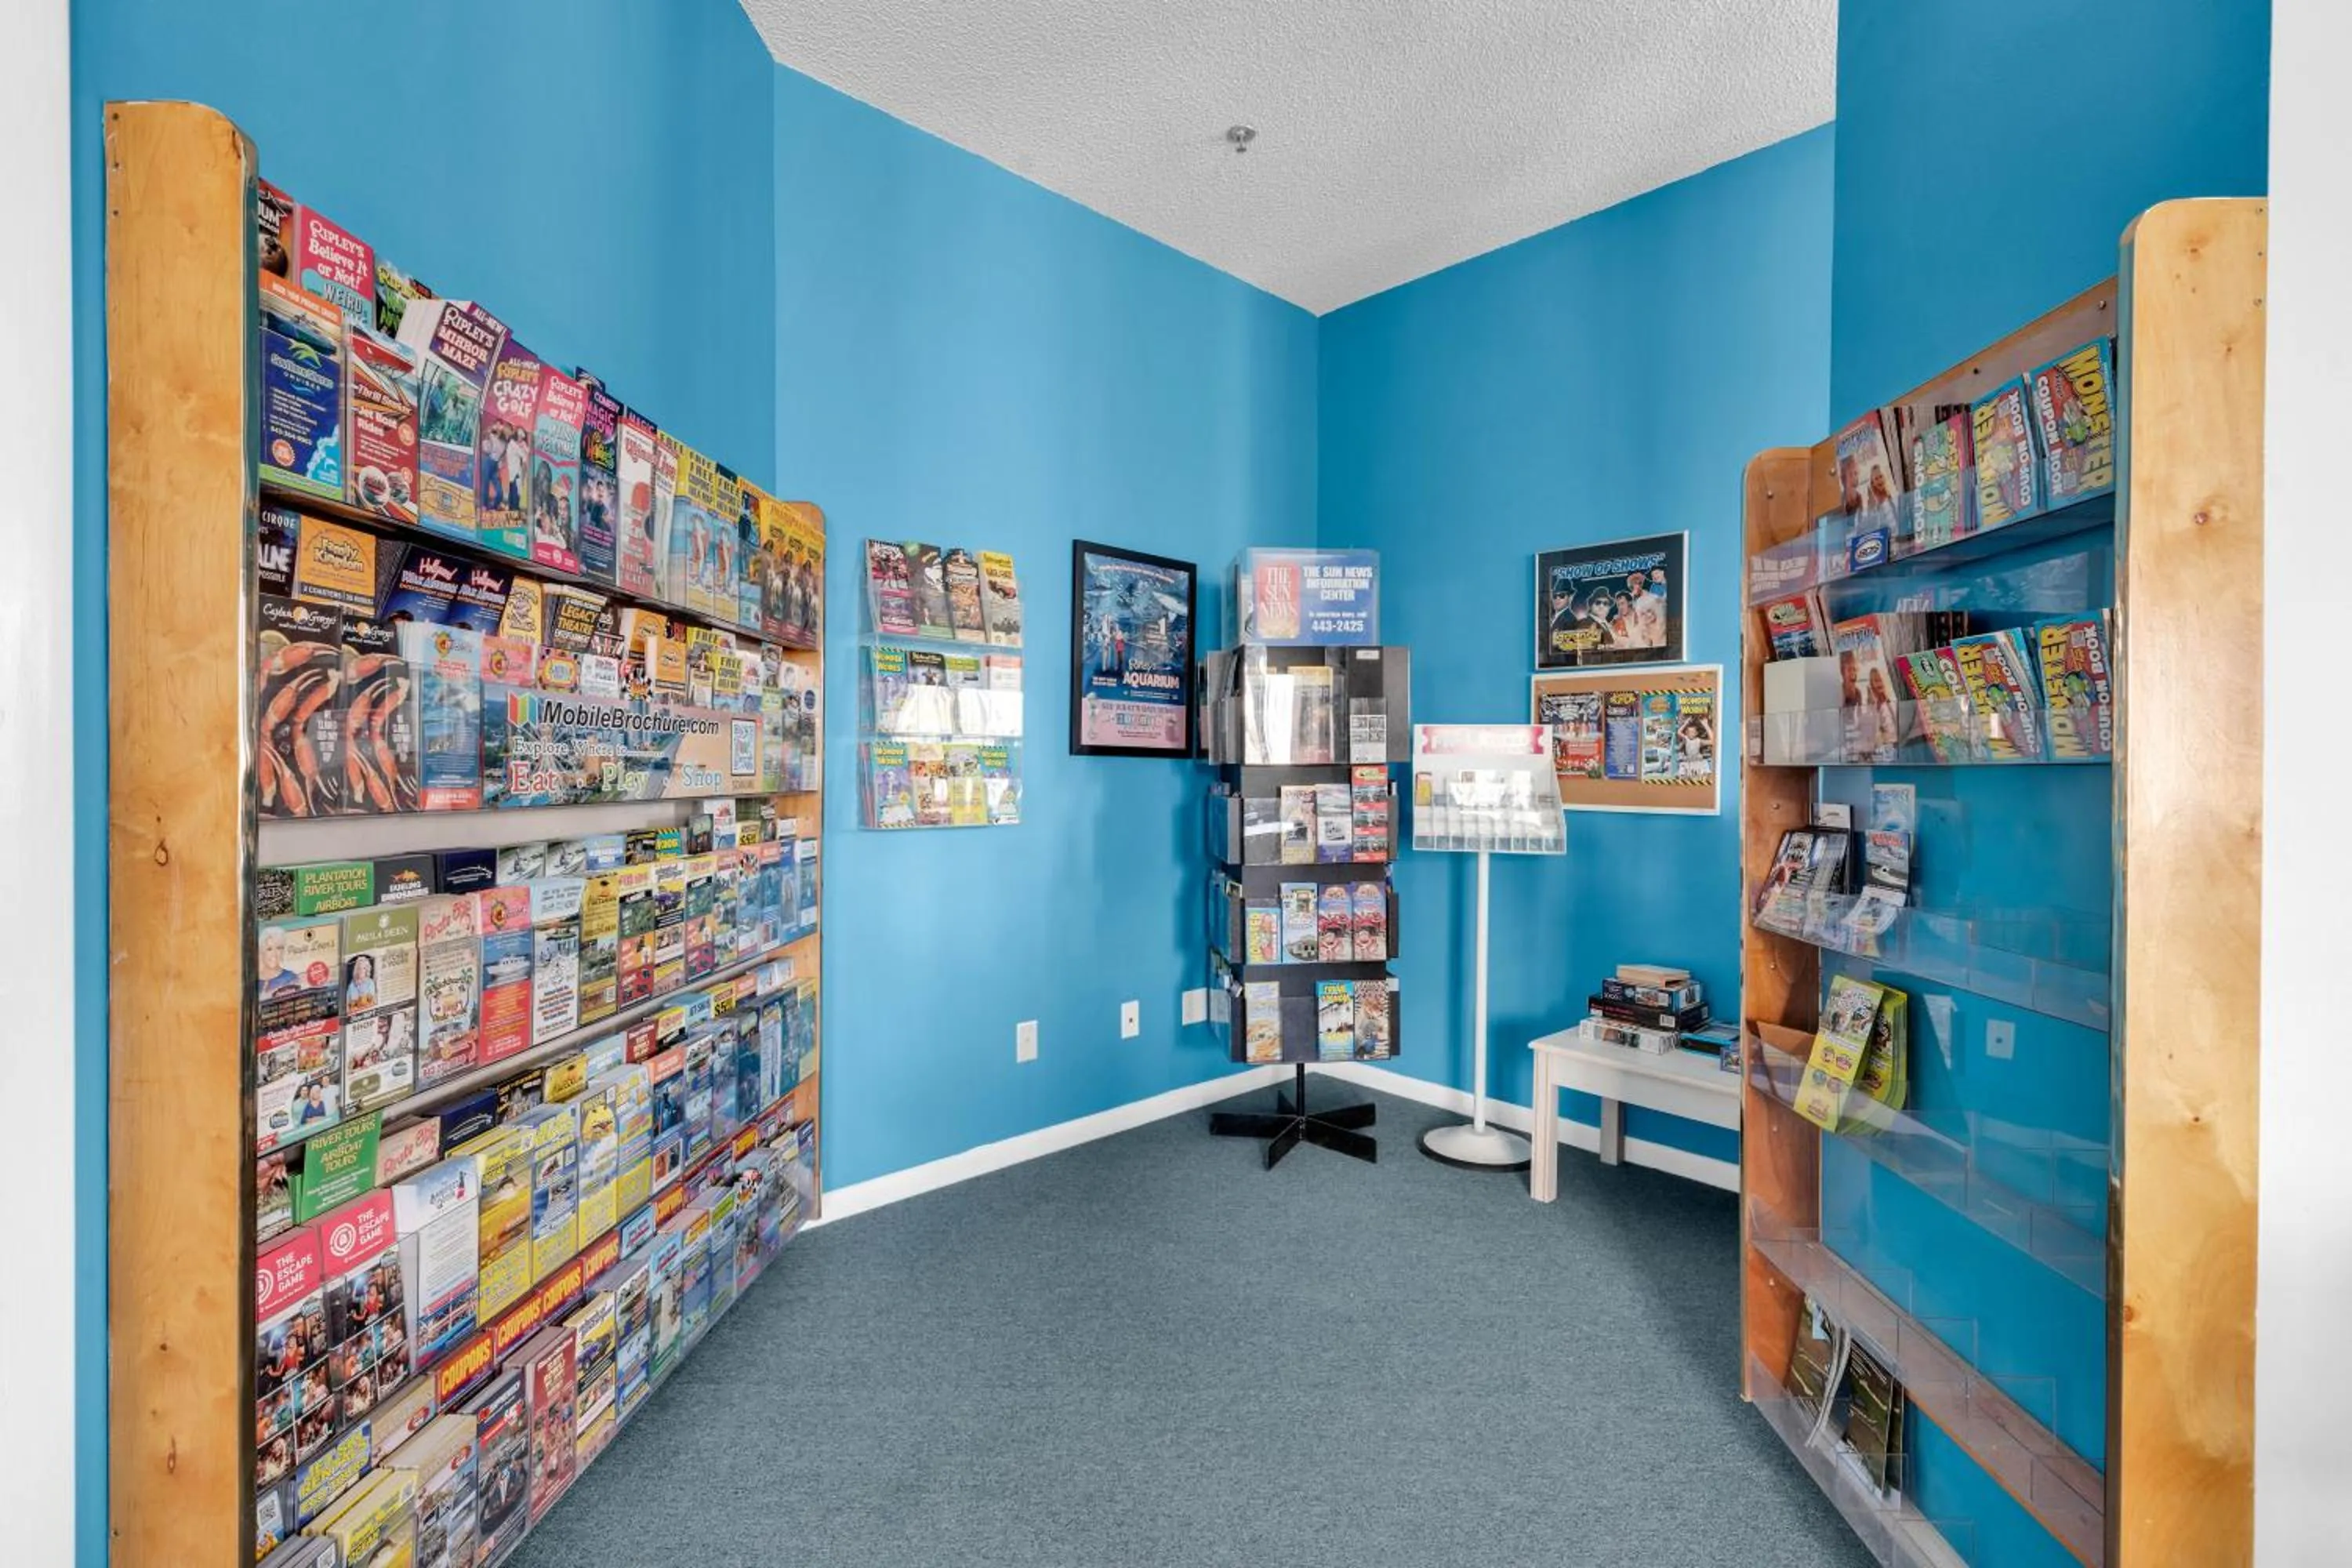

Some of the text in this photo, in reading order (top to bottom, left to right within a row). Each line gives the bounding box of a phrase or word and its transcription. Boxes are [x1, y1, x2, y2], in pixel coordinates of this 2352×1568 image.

[310, 220, 365, 258] RIPLEY'S
[309, 238, 368, 275] Believe It
[318, 262, 362, 289] or Not!
[444, 307, 495, 348] RIPLEY'S
[443, 343, 477, 371] MAZE
[494, 380, 539, 403] CRAZY
[497, 397, 532, 419] GOLF
[2038, 376, 2060, 444] COUPON
[262, 510, 296, 529] CIRQUE
[1267, 567, 1291, 584] THE
[1302, 566, 1373, 578] THE SUN NEWS
[1306, 579, 1369, 590] INFORMATION
[1320, 590, 1355, 601] CENTER
[1312, 620, 1364, 632] 443-2425
[1123, 673, 1180, 689] AQUARIUM
[2084, 624, 2112, 752] COUPON BOOK
[543, 700, 719, 735] MobileBrochure.com
[512, 736, 568, 758] Explore
[510, 761, 557, 794] Eat
[601, 761, 652, 800] Play
[305, 867, 366, 884] PLANTATION
[303, 883, 335, 896] RIVER
[337, 880, 367, 893] TOURS
[357, 1209, 375, 1223] THE
[358, 1210, 390, 1235] ESCAPE
[360, 1226, 383, 1245] GAME
[275, 1253, 294, 1268] THE
[277, 1254, 313, 1281] ESCAPE
[278, 1271, 304, 1292] GAME
[441, 1337, 491, 1395] COUPONS
